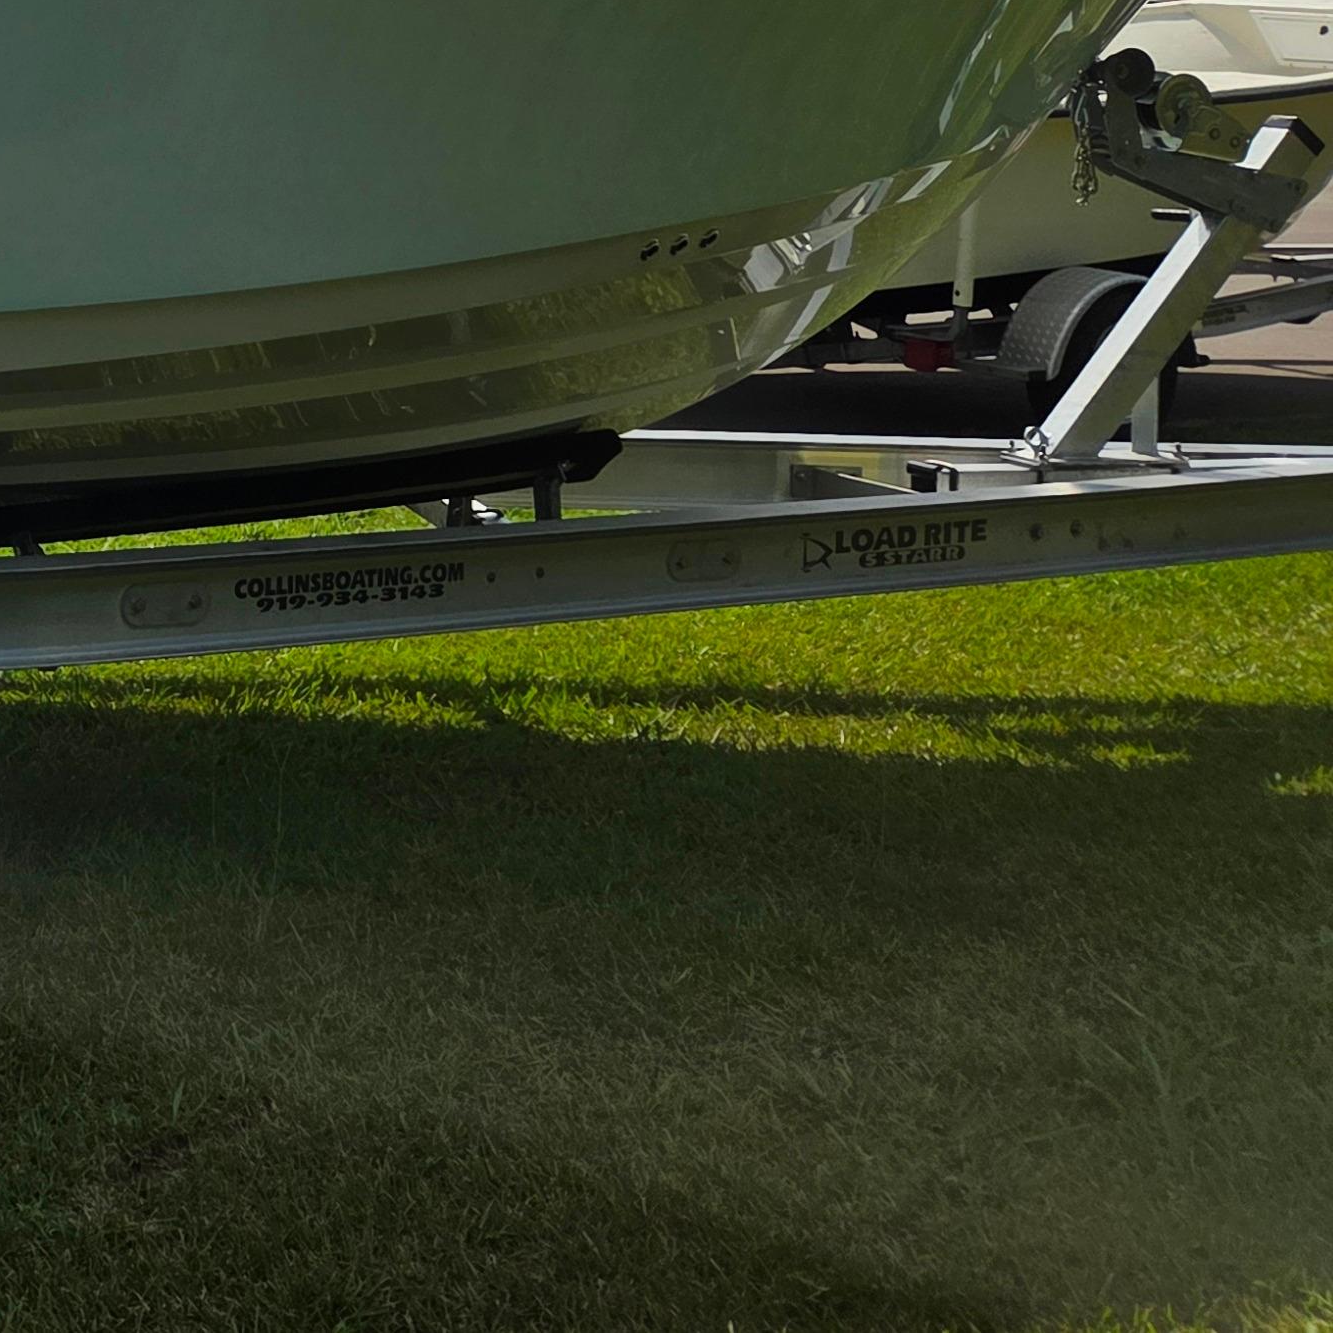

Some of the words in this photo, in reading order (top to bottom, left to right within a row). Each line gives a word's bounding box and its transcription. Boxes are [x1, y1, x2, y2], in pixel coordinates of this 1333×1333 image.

[834, 525, 916, 554] LOAD
[924, 519, 987, 547] RITE
[883, 546, 960, 565] STARR
[234, 562, 464, 599] COLLINSBOATING.COM
[256, 584, 445, 613] 919-934-3143
